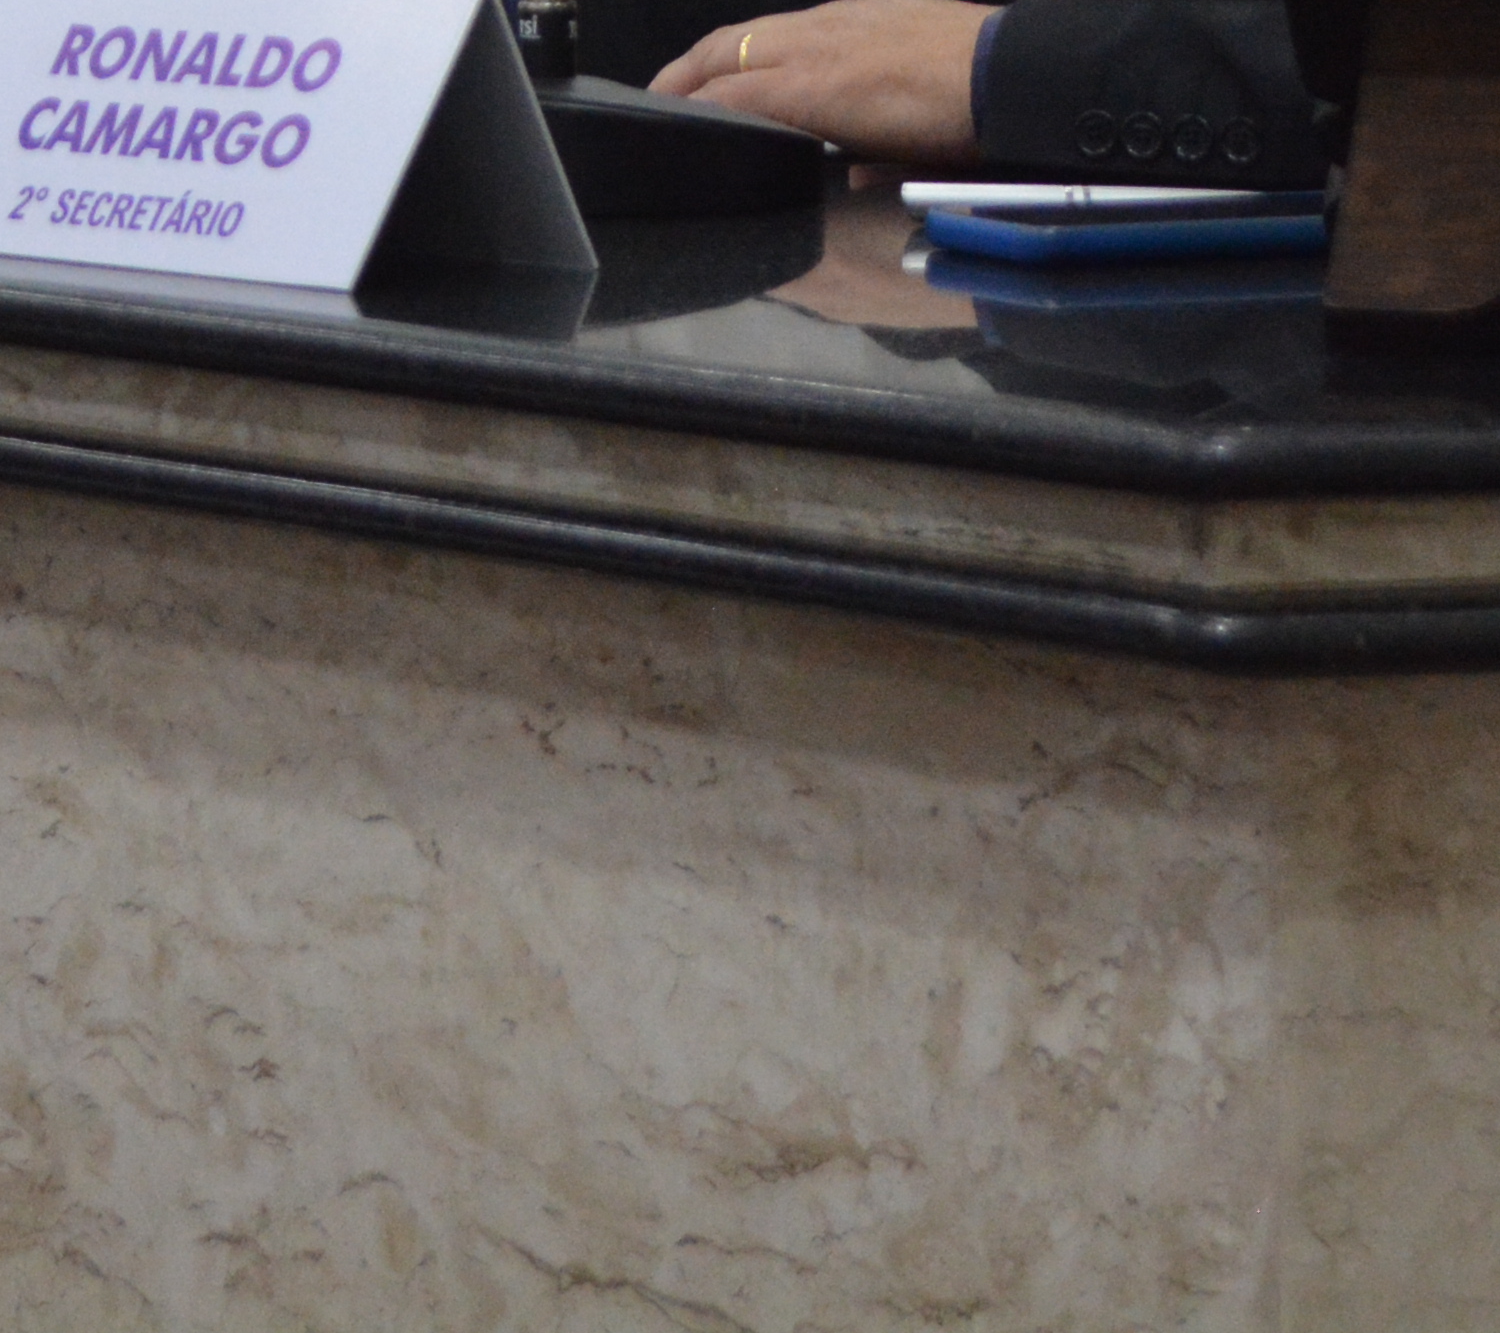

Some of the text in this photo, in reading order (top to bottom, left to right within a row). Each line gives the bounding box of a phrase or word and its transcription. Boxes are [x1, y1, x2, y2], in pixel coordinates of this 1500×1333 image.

[49, 23, 343, 93] RONALDO
[18, 95, 312, 169] CAMARGO
[49, 190, 246, 238] SECRETÁRIO
